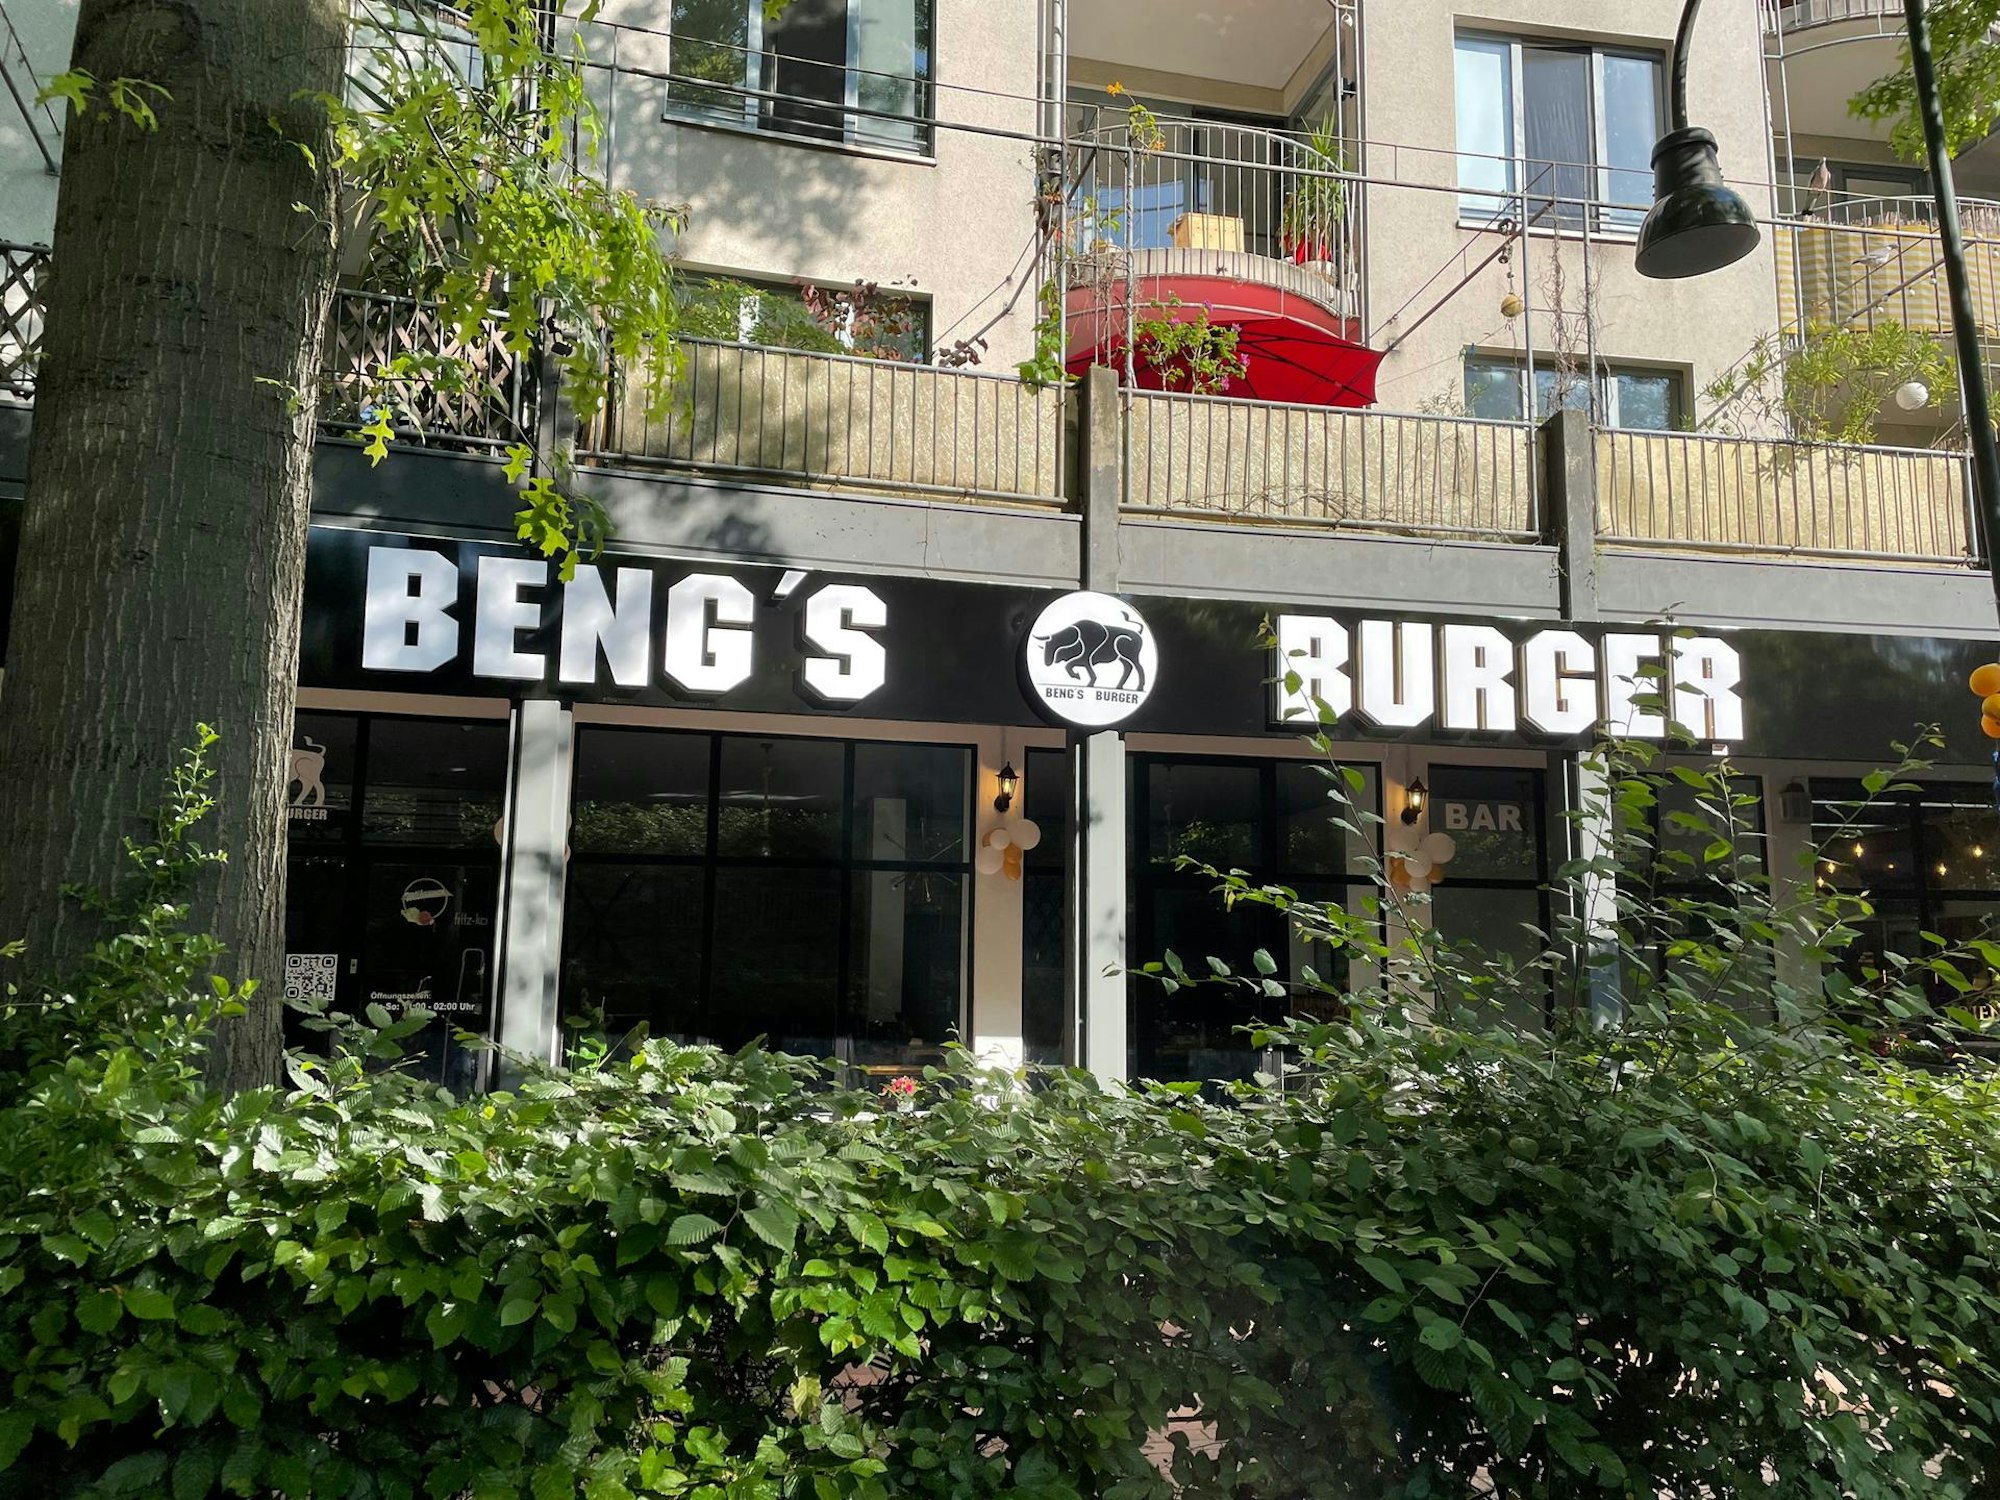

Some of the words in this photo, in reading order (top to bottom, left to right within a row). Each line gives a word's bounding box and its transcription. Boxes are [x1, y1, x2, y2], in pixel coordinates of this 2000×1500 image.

[1276, 614, 1744, 740] BURGER
[1095, 690, 1139, 705] BURGER
[288, 807, 328, 820] URGER
[1445, 803, 1523, 831] BAR
[459, 1002, 475, 1010] Uhr
